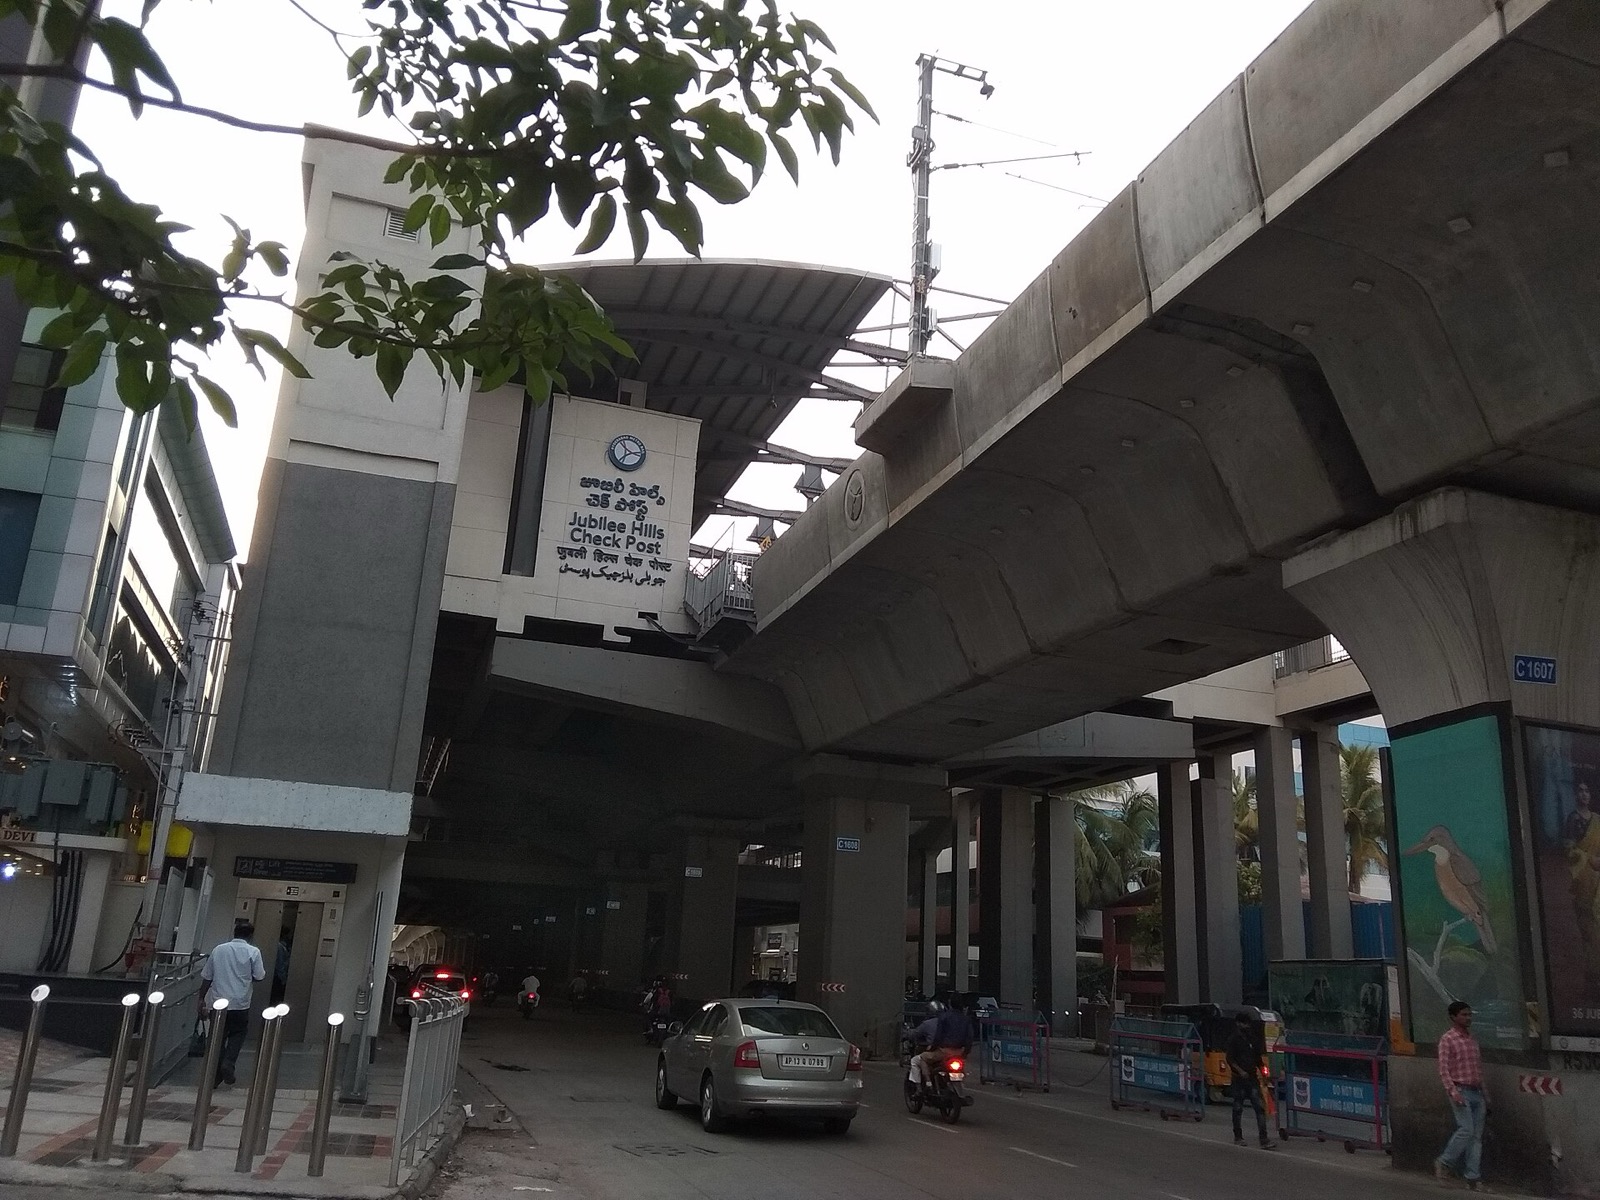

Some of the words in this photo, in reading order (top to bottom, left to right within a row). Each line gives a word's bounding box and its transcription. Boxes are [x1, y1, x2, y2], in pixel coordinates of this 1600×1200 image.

[579, 477, 625, 494] జూబిలీ
[586, 493, 611, 509] చెక్
[569, 511, 626, 533] Jubilee
[631, 520, 665, 539] Hills
[570, 527, 621, 549] Check
[626, 535, 661, 555] Post
[593, 548, 619, 564] हिल्स
[624, 552, 643, 567] चेक
[649, 556, 672, 572] पोस्ट
[3, 830, 36, 842] DEVI
